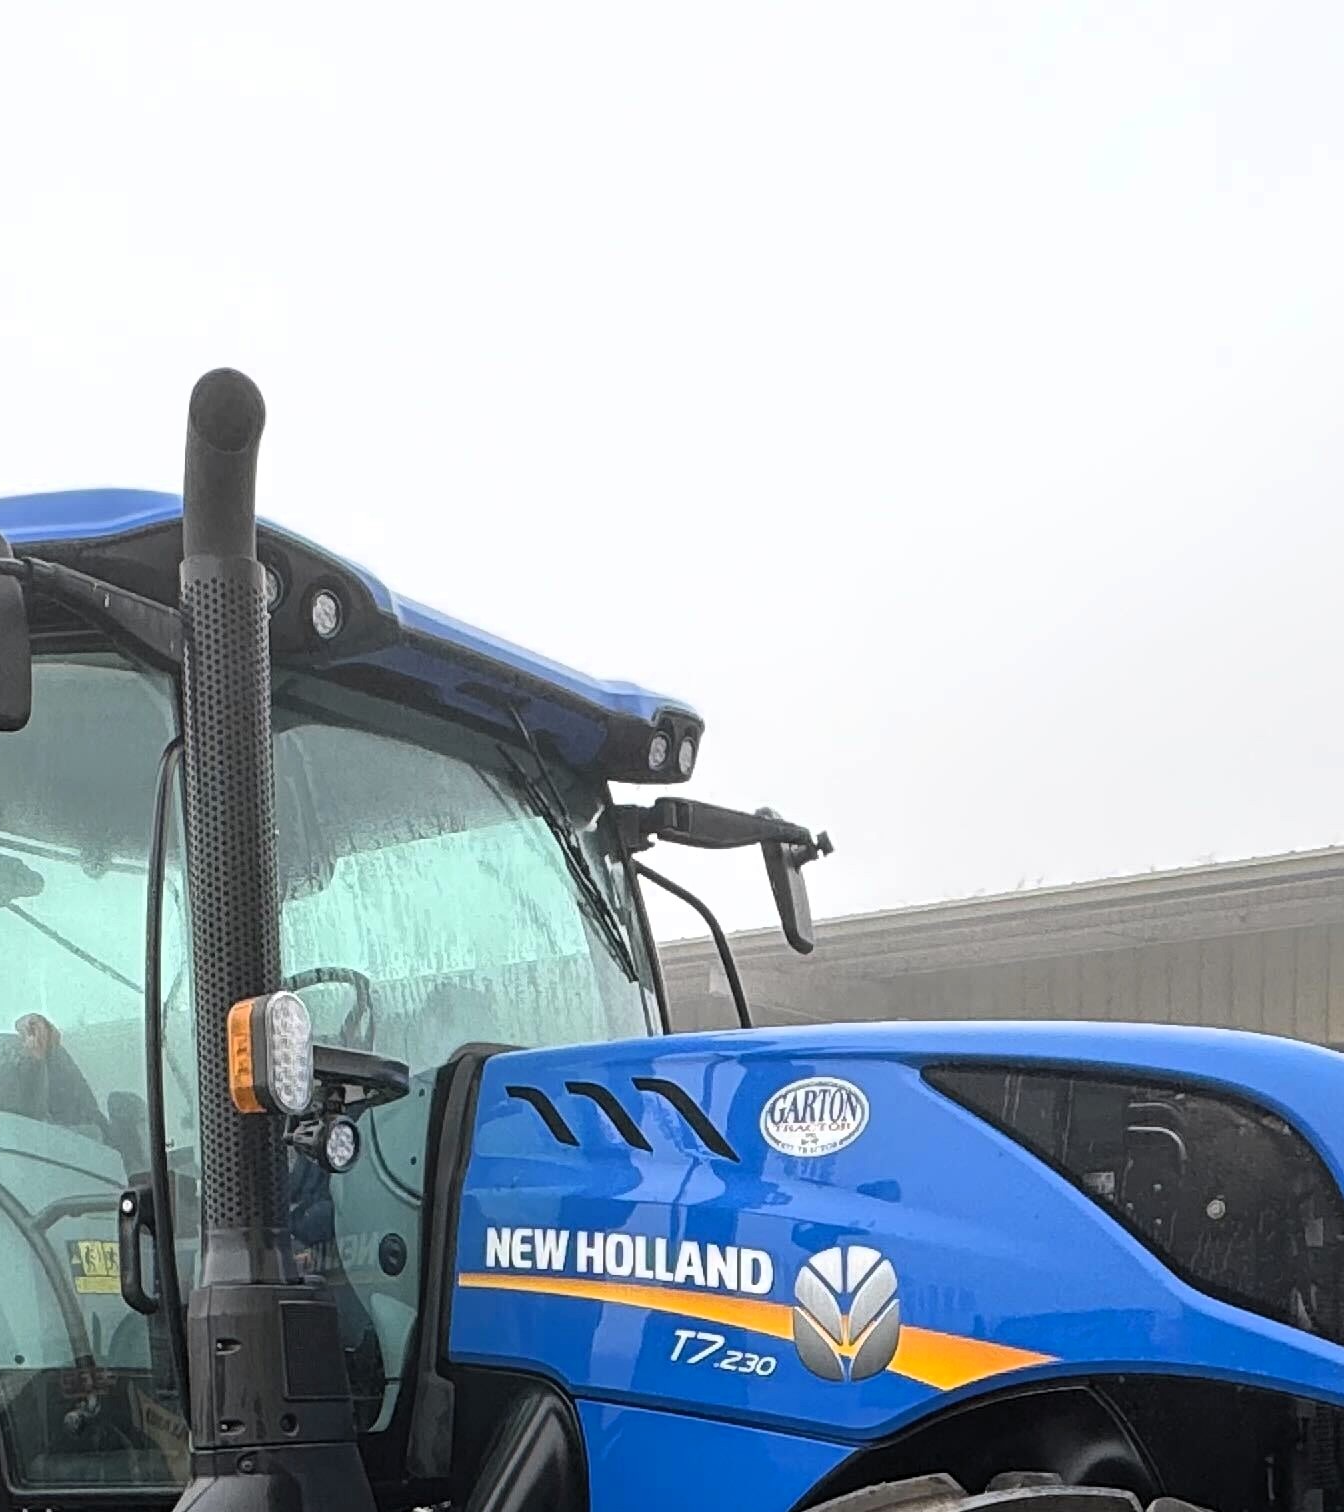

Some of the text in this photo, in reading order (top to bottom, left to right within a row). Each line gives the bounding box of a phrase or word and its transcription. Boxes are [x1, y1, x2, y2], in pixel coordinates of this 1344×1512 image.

[768, 1087, 862, 1126] GARTON
[773, 1122, 853, 1133] TRACTOR
[486, 1228, 774, 1294] NEW HOLLAND
[671, 1329, 776, 1376] T7.230
